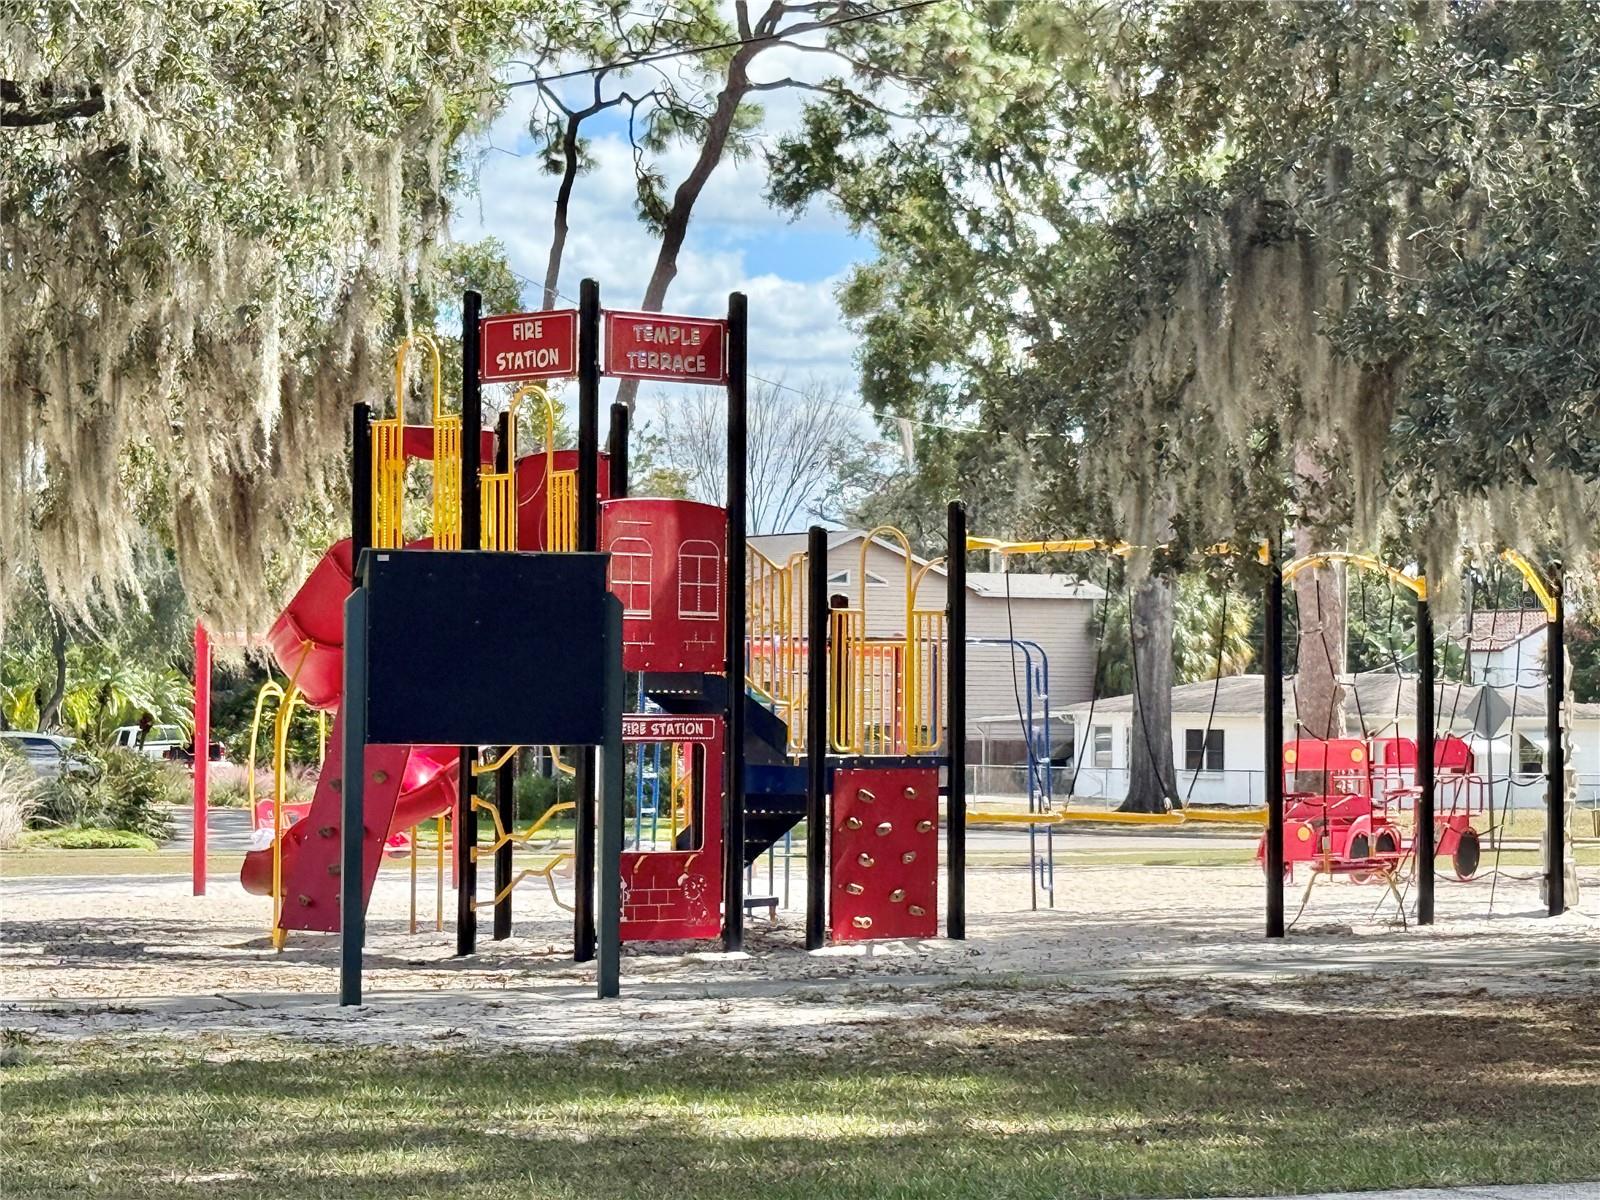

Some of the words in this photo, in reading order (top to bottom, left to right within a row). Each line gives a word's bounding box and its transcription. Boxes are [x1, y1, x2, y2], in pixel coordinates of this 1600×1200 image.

[512, 320, 543, 341] FIRE
[632, 324, 701, 346] TEMPLE
[496, 348, 559, 371] STATION
[626, 351, 706, 373] TERRACE
[622, 721, 646, 735] FIRE
[650, 722, 703, 735] STATION
